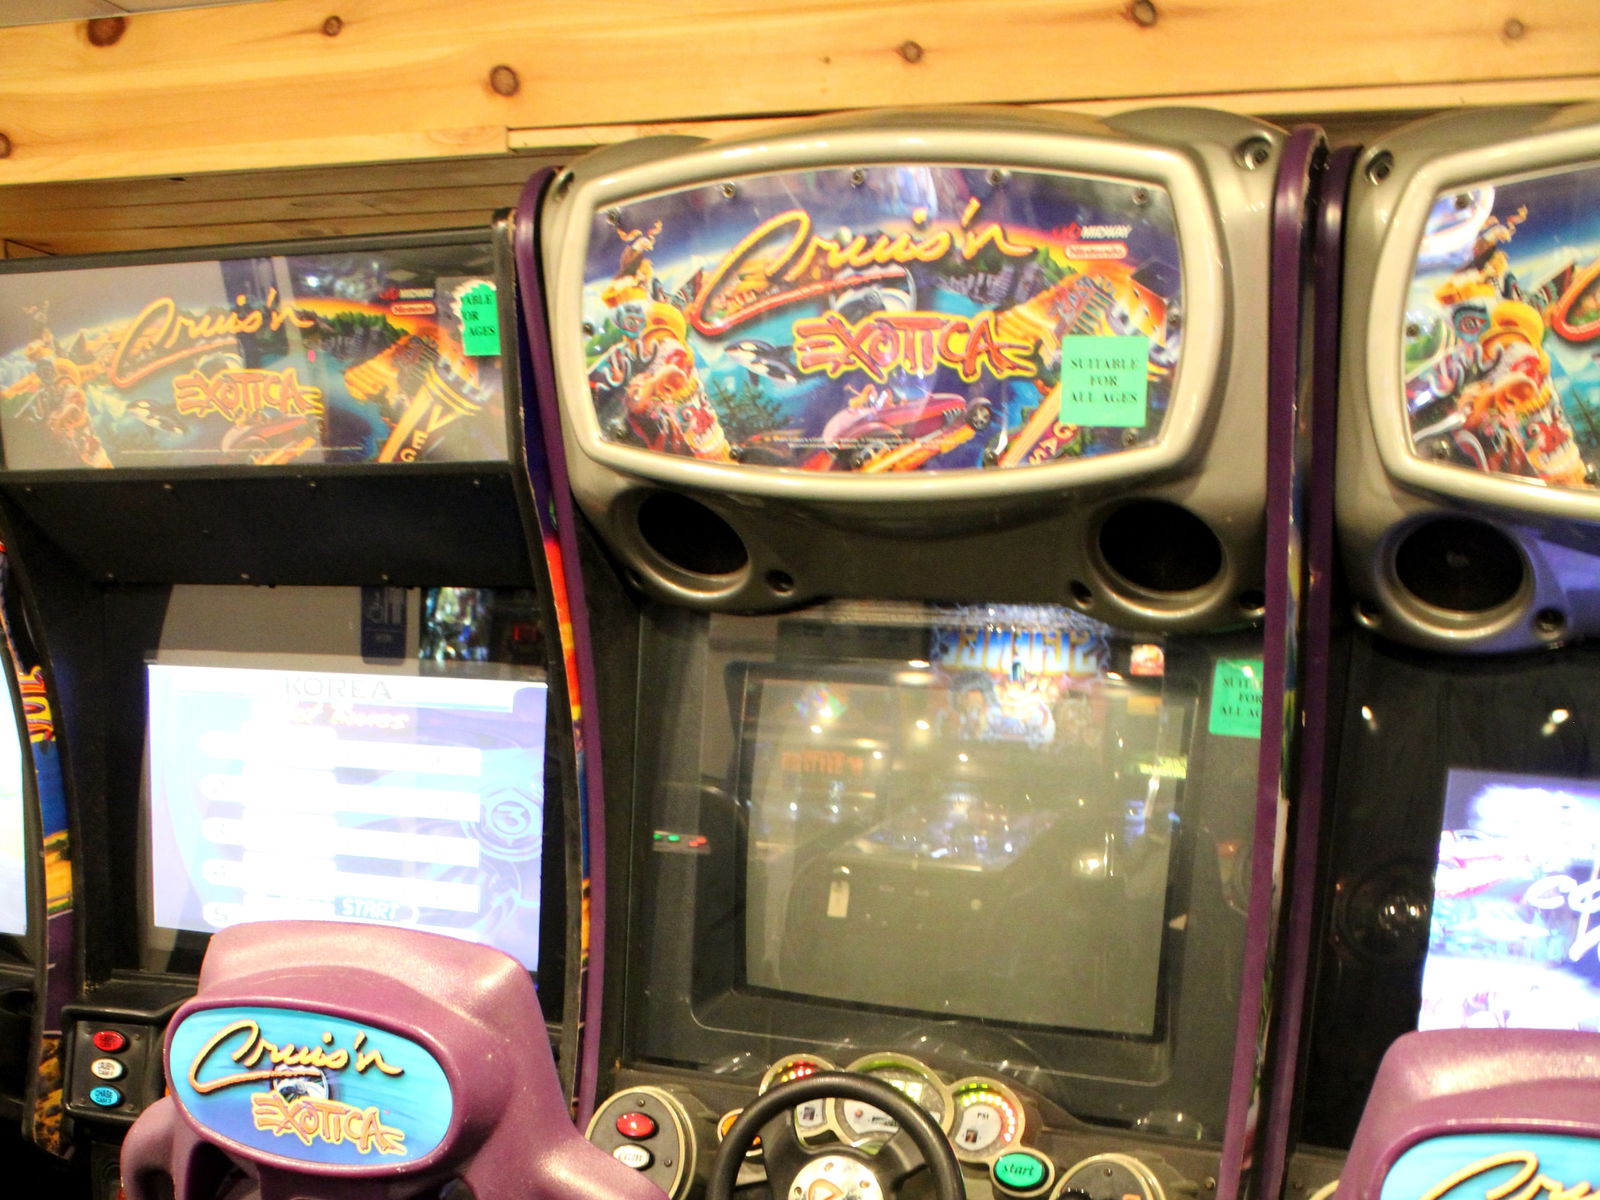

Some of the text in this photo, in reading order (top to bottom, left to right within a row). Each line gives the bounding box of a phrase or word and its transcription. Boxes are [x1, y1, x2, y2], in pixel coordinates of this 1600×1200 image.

[690, 197, 1036, 335] Cruis'n
[108, 287, 316, 389] Cruis'n
[793, 310, 1039, 384] EXOTICA
[1070, 358, 1139, 370] SUITABLE
[1090, 375, 1118, 387] FOR
[173, 366, 325, 424] EXOTICA
[1071, 392, 1138, 403] ALL AGES
[284, 675, 393, 700] KOREA
[341, 897, 401, 921] START
[188, 1018, 403, 1093] Cruis'n
[251, 1089, 408, 1156] EXOTICA
[1002, 1162, 1035, 1177] start
